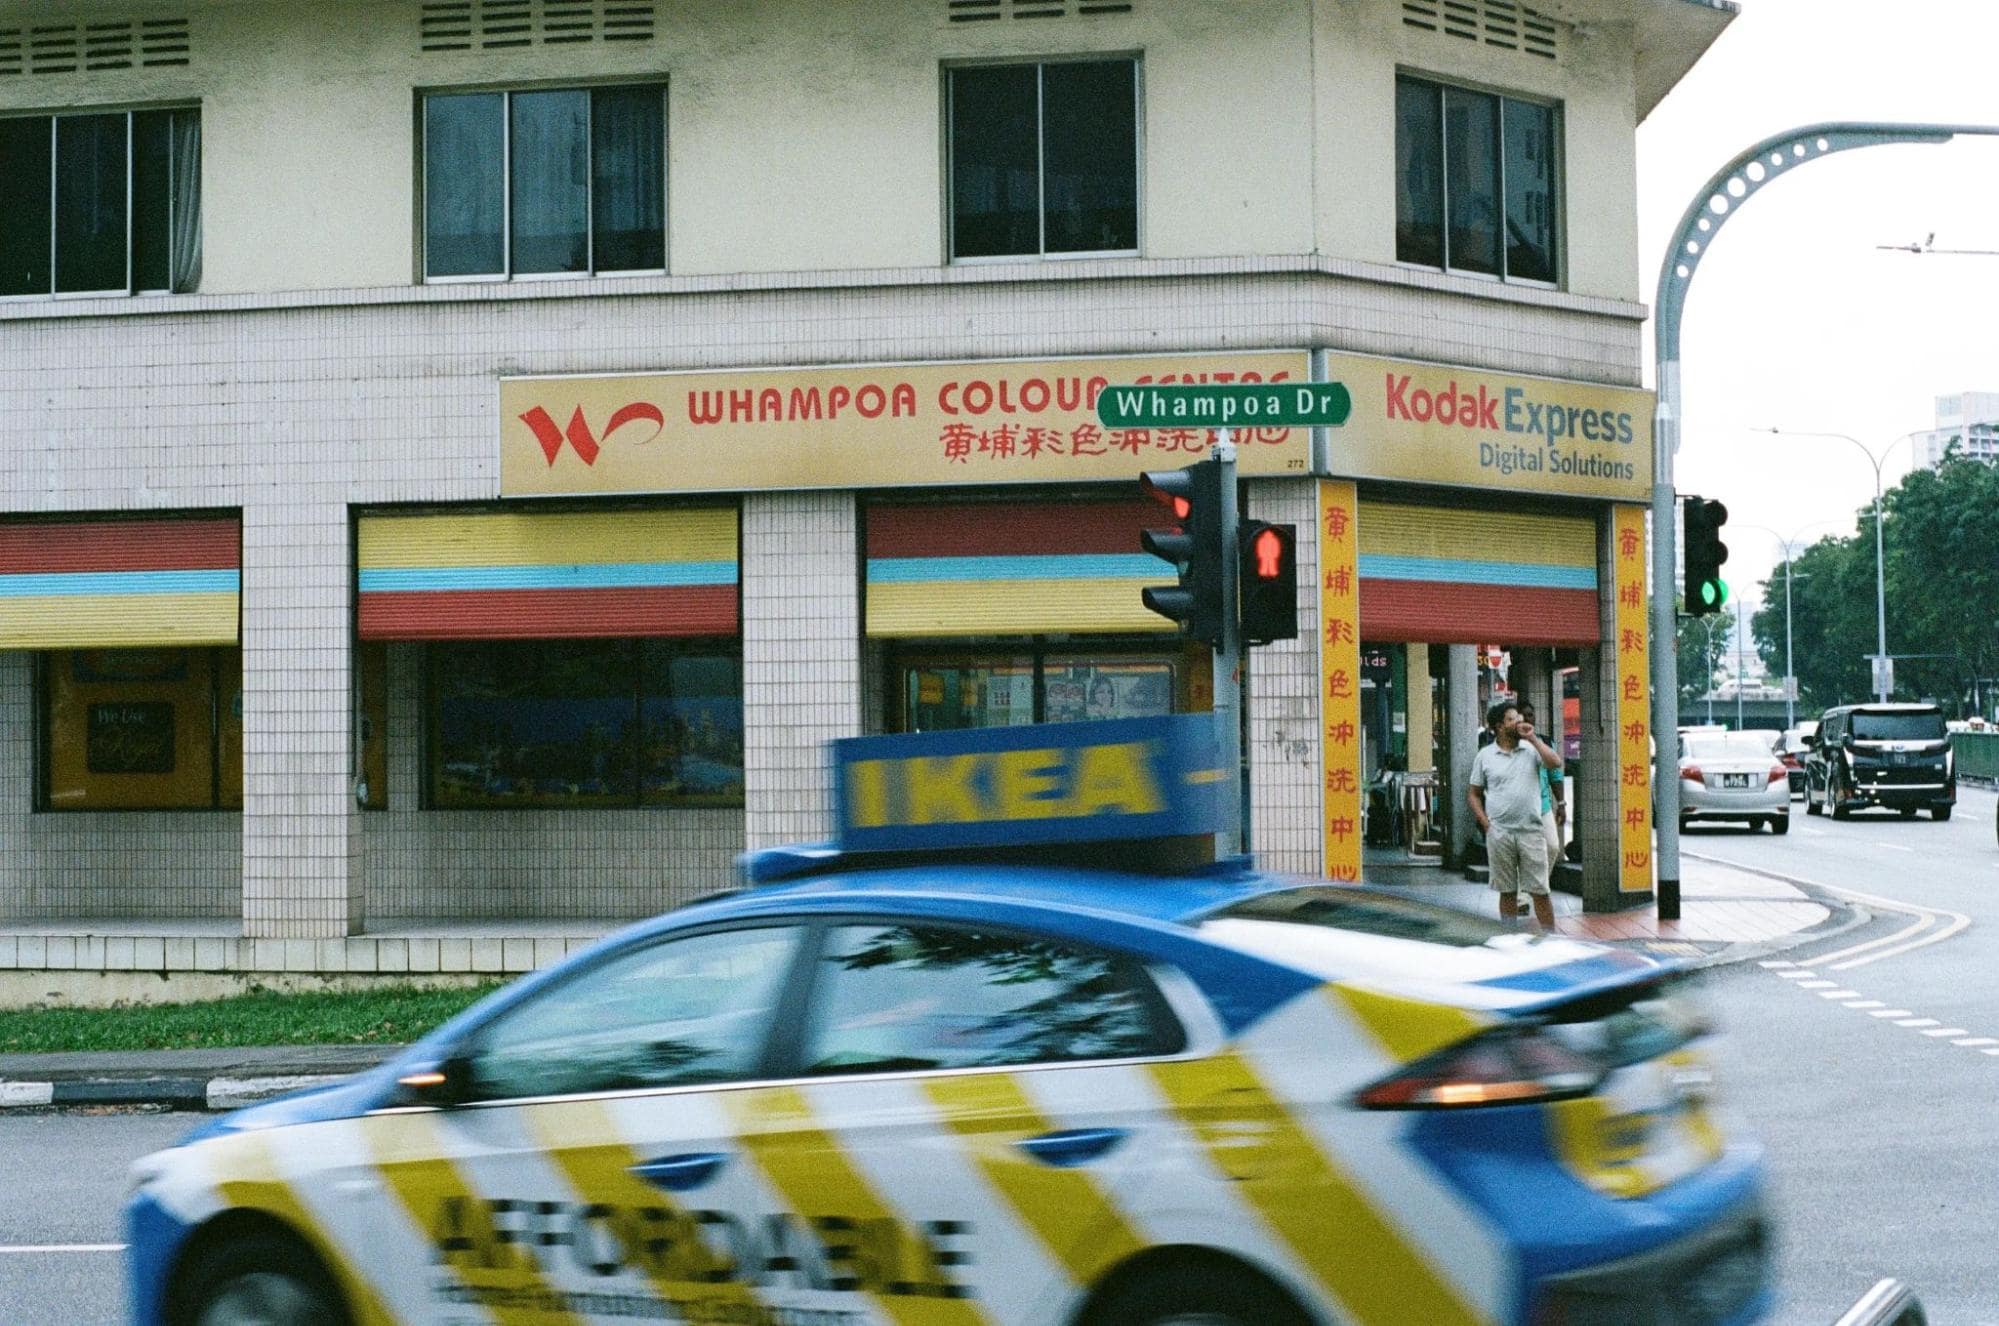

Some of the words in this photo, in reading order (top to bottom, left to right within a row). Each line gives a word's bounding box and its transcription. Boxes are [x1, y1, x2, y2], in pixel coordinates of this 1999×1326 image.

[688, 382, 917, 424] WHAMPOA
[1117, 390, 1280, 422] Whampoa
[1297, 388, 1331, 414] Dr
[1386, 373, 1499, 430] Kodak
[1504, 387, 1633, 446] Express
[1480, 442, 1543, 475] Digital
[1550, 448, 1633, 481] Solutions
[850, 742, 1165, 828] IKEA
